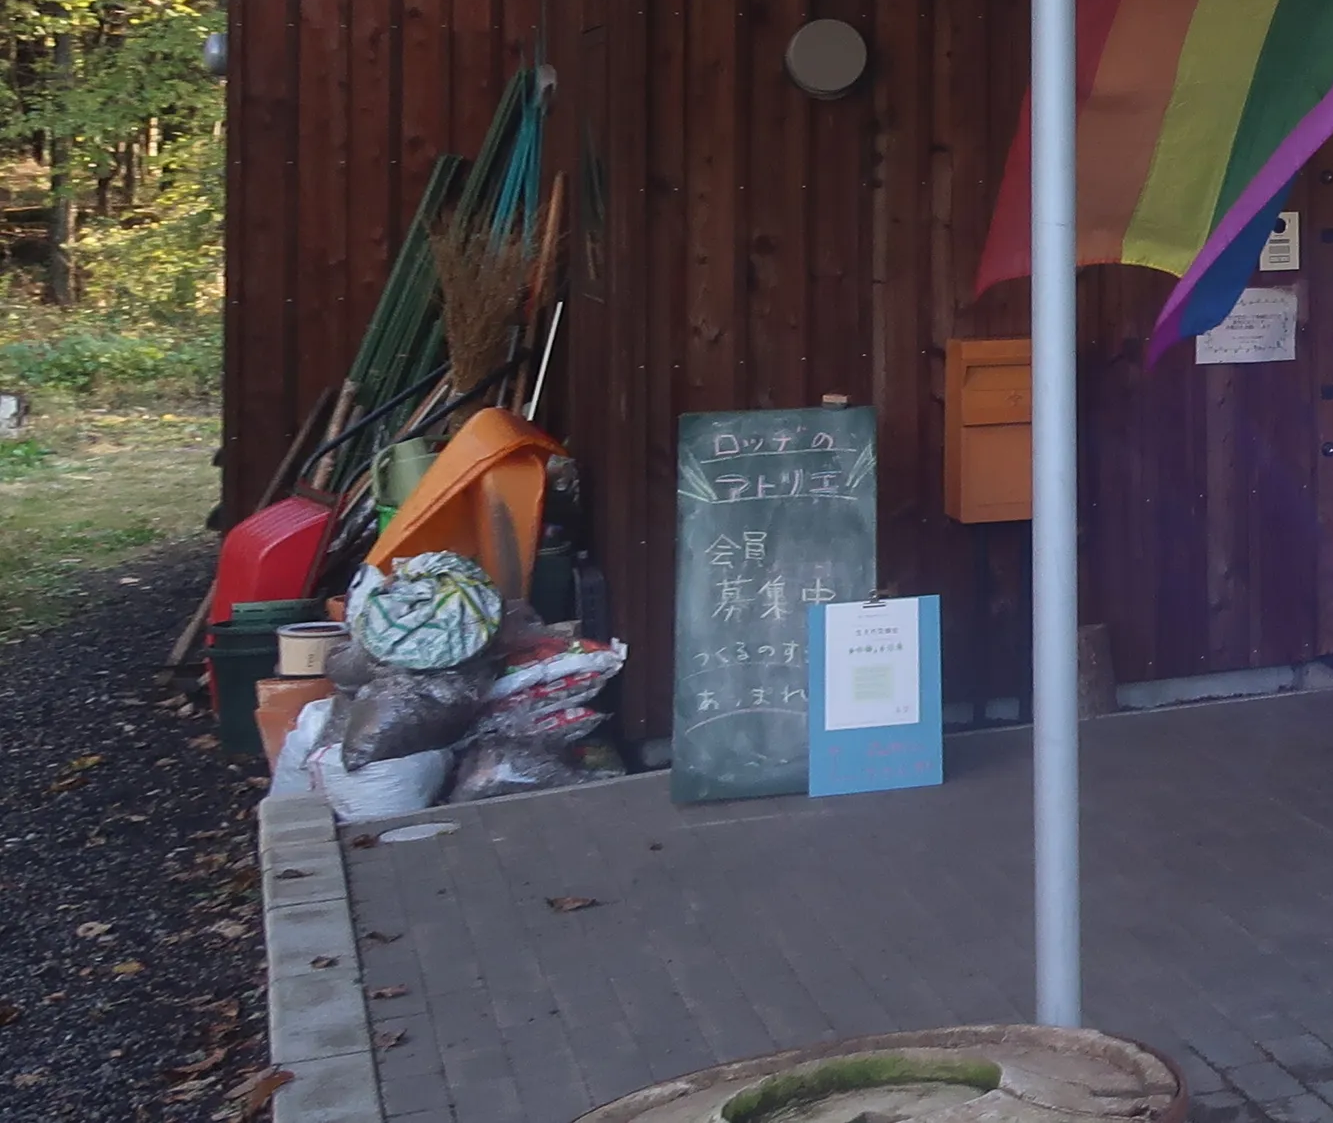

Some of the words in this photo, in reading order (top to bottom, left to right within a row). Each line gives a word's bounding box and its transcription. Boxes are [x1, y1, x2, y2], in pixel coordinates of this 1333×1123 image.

[714, 468, 842, 500] アトリエ
[705, 530, 768, 569] 会員
[711, 574, 837, 622] 募集中
[692, 640, 810, 666] つくるのす
